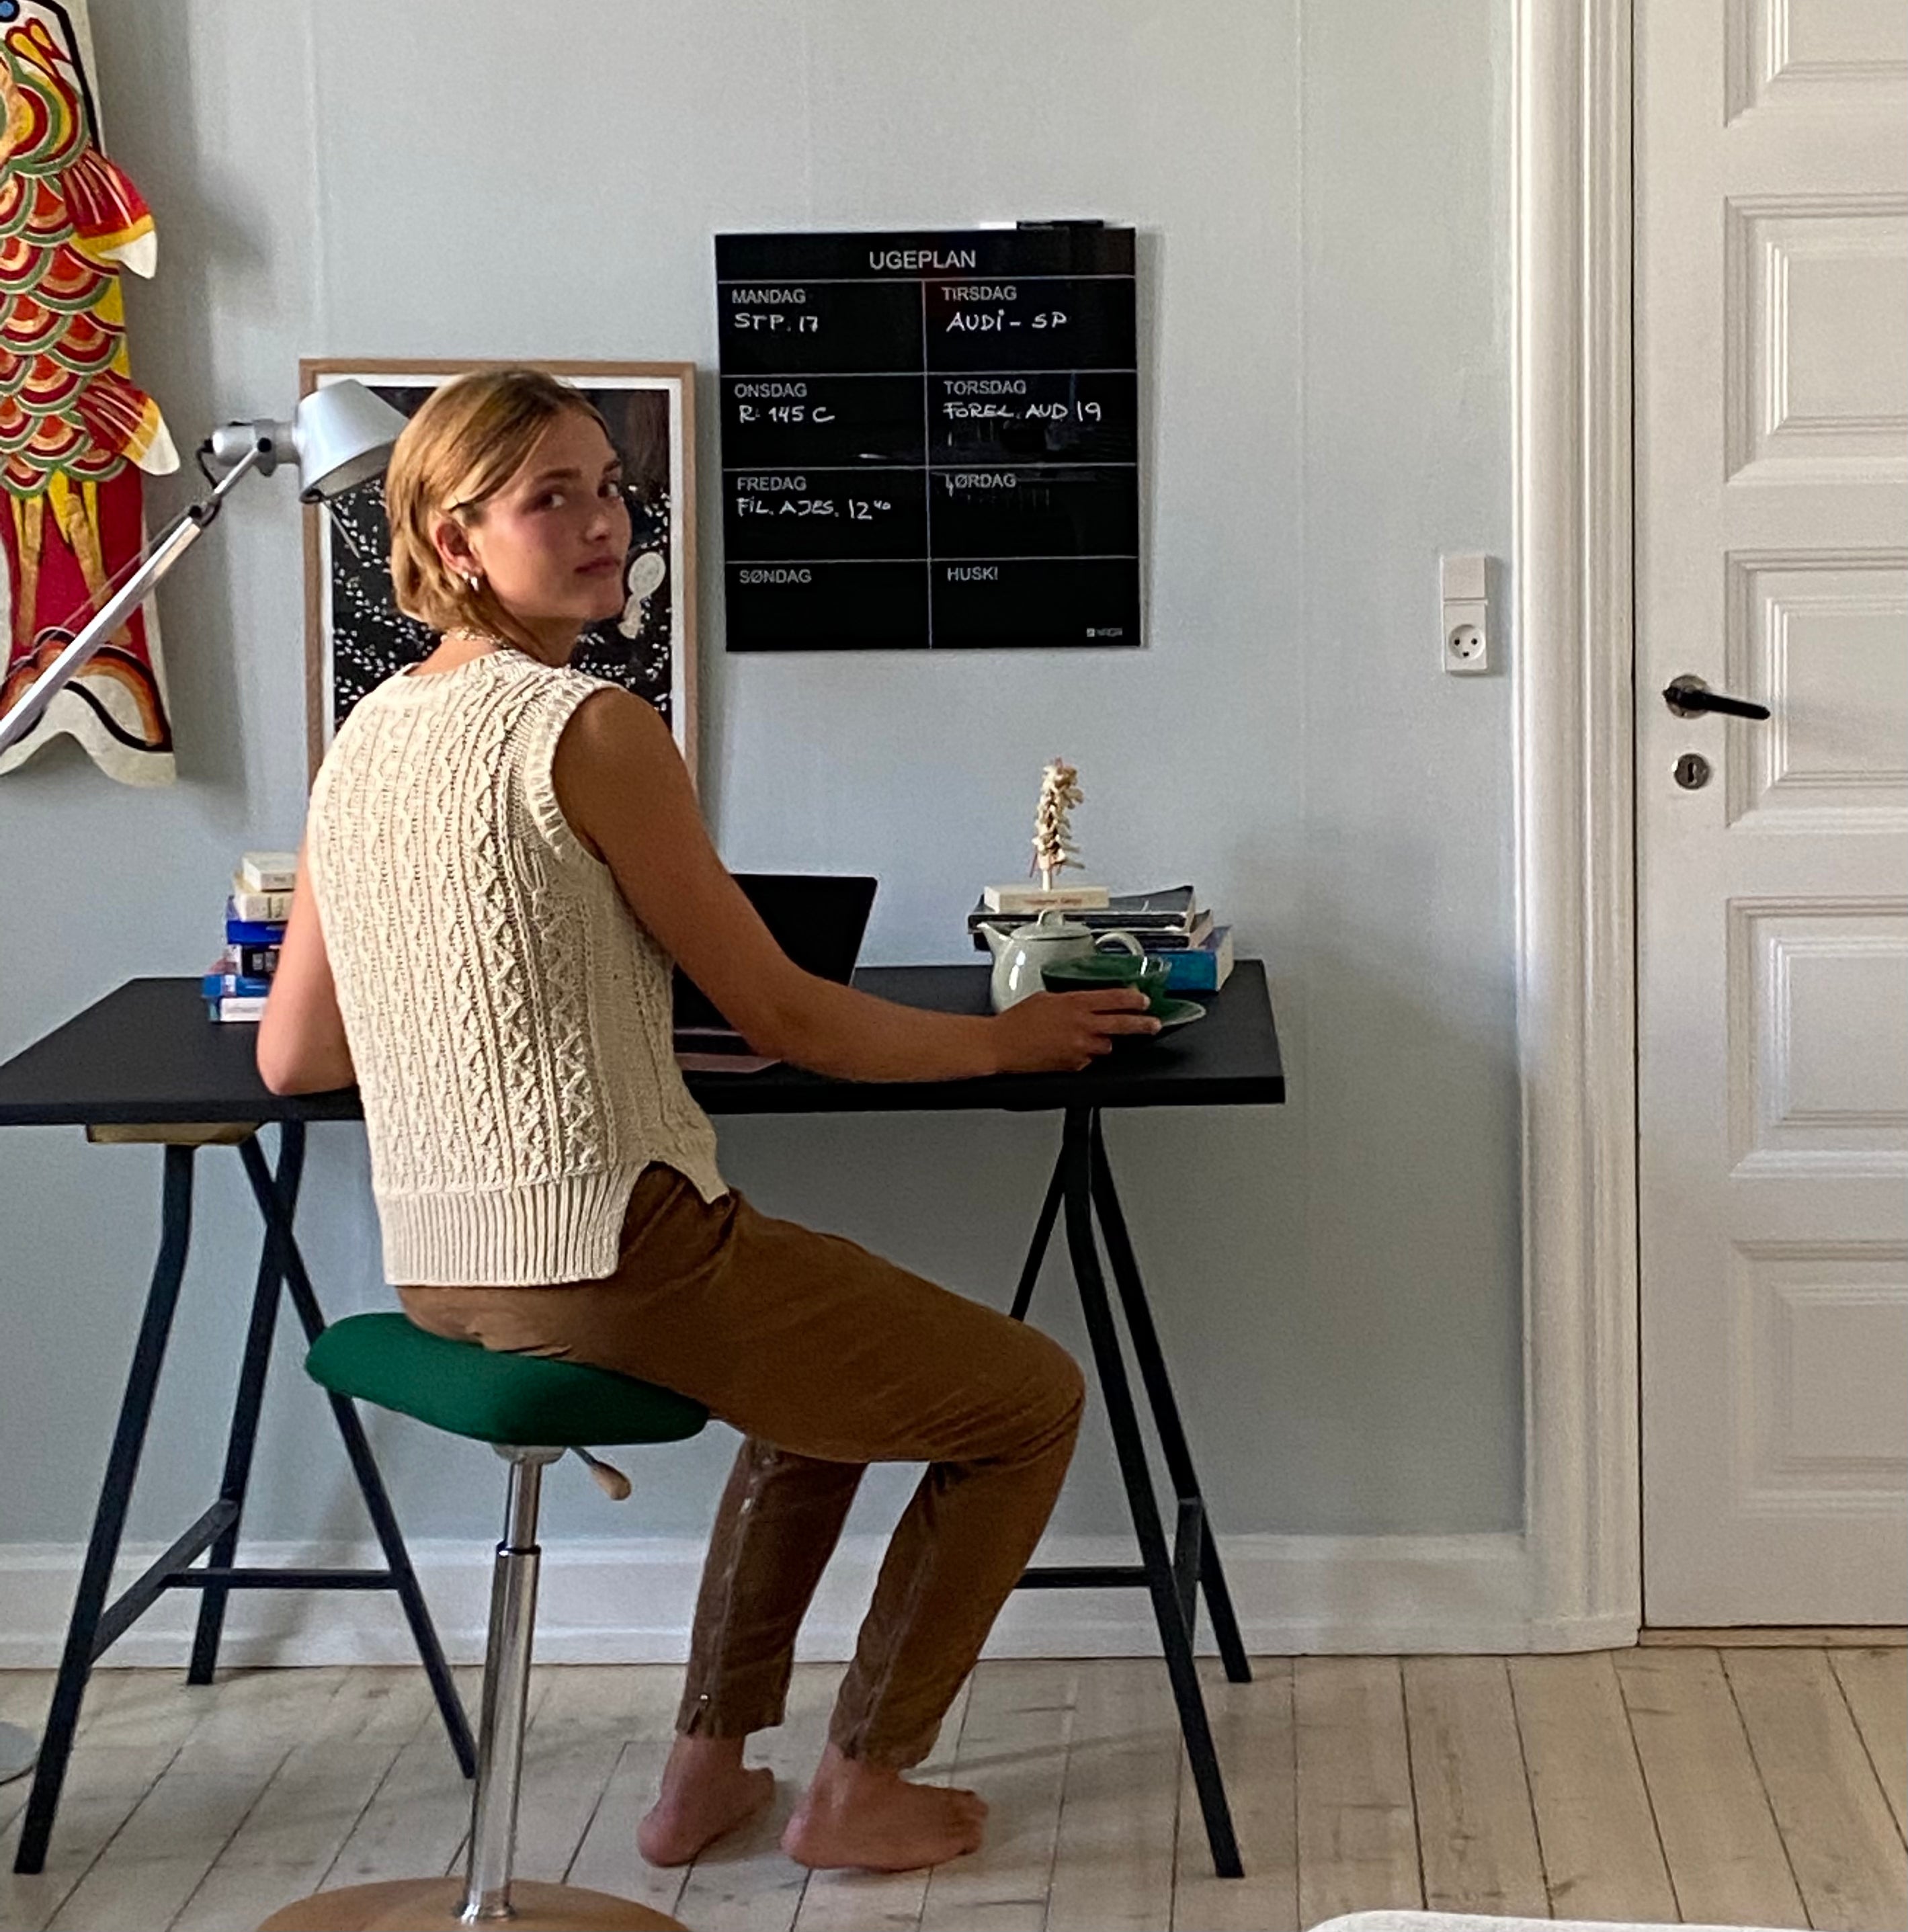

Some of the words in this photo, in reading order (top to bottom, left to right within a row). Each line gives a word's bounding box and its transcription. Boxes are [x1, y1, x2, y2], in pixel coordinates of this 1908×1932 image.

[870, 250, 975, 269] UGEPLAN
[732, 289, 805, 303] MANDAG
[942, 286, 1017, 301] TIRSDAG
[800, 316, 818, 332] 17
[735, 383, 806, 398] ONSDAG
[944, 380, 1026, 394] TORSDAG
[769, 406, 804, 423] 145
[813, 407, 835, 422] C
[1077, 401, 1101, 421] 19
[738, 476, 806, 491] FREDAG
[740, 569, 811, 583] SØNDAG
